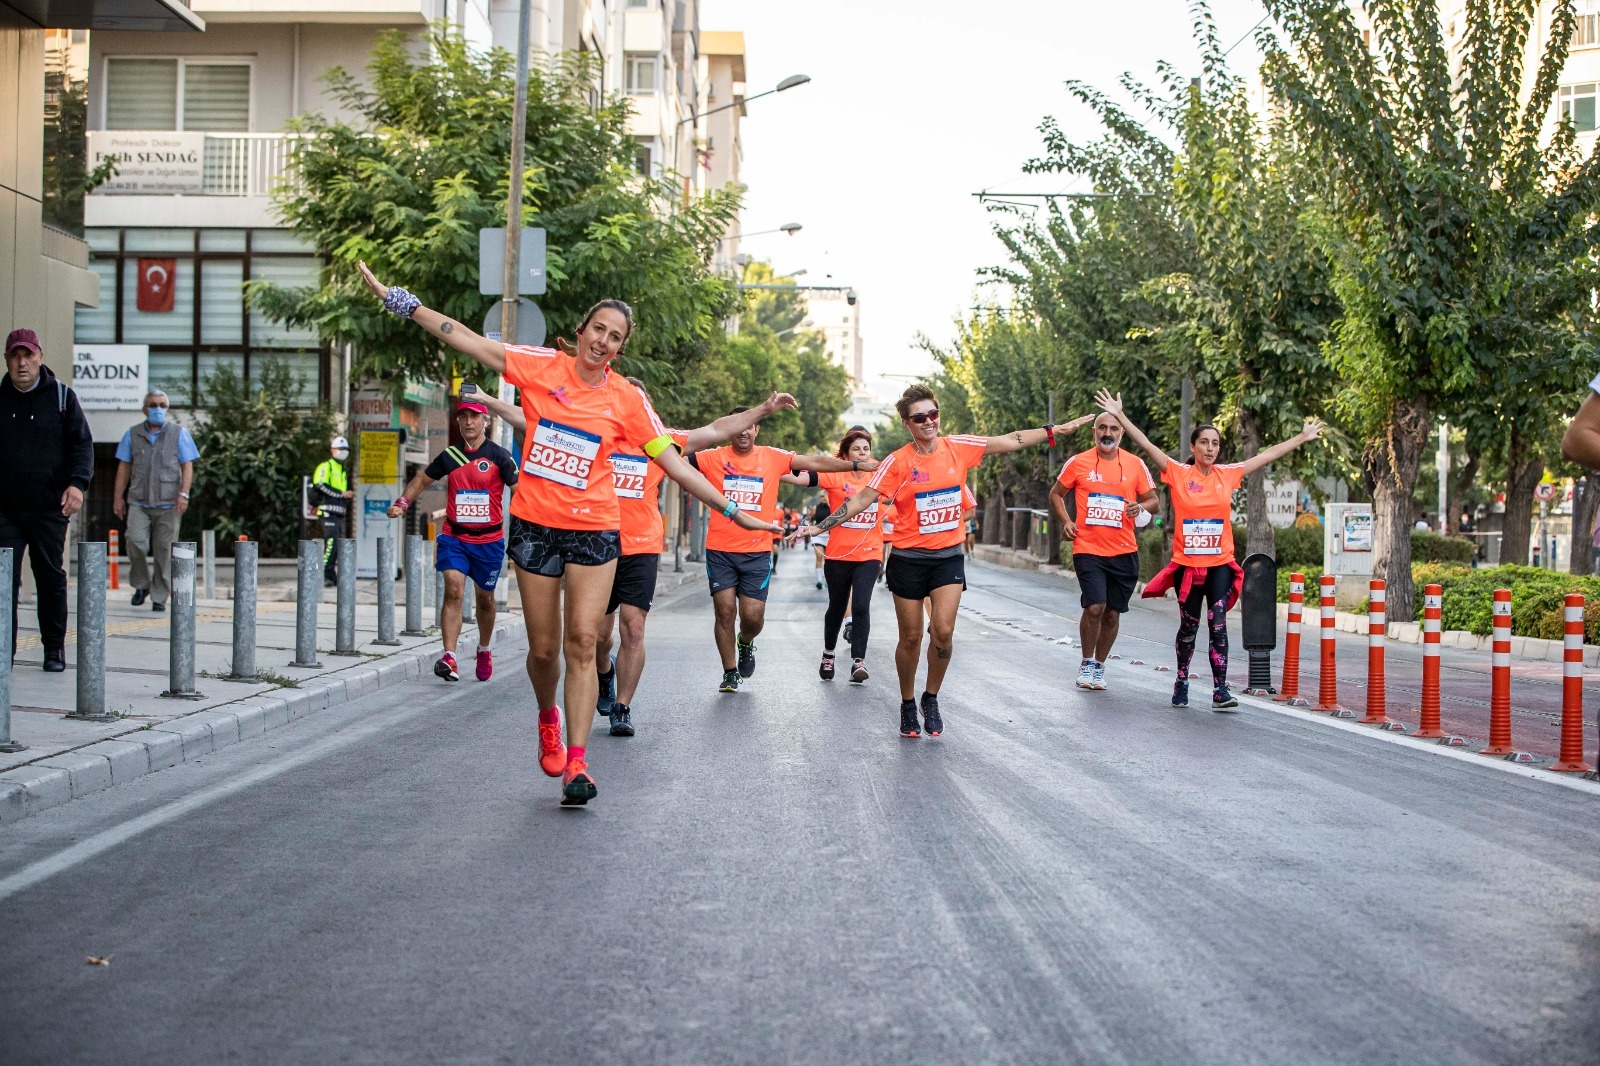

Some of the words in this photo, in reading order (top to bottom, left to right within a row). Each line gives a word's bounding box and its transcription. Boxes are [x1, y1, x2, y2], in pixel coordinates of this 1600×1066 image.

[138, 150, 197, 165] ŞENDAĞ
[529, 443, 591, 478] 50285
[724, 491, 761, 504] 50127
[456, 505, 489, 516] 50355
[920, 505, 961, 525] 50773
[1087, 508, 1122, 520] 50705
[1184, 536, 1221, 547] 50517
